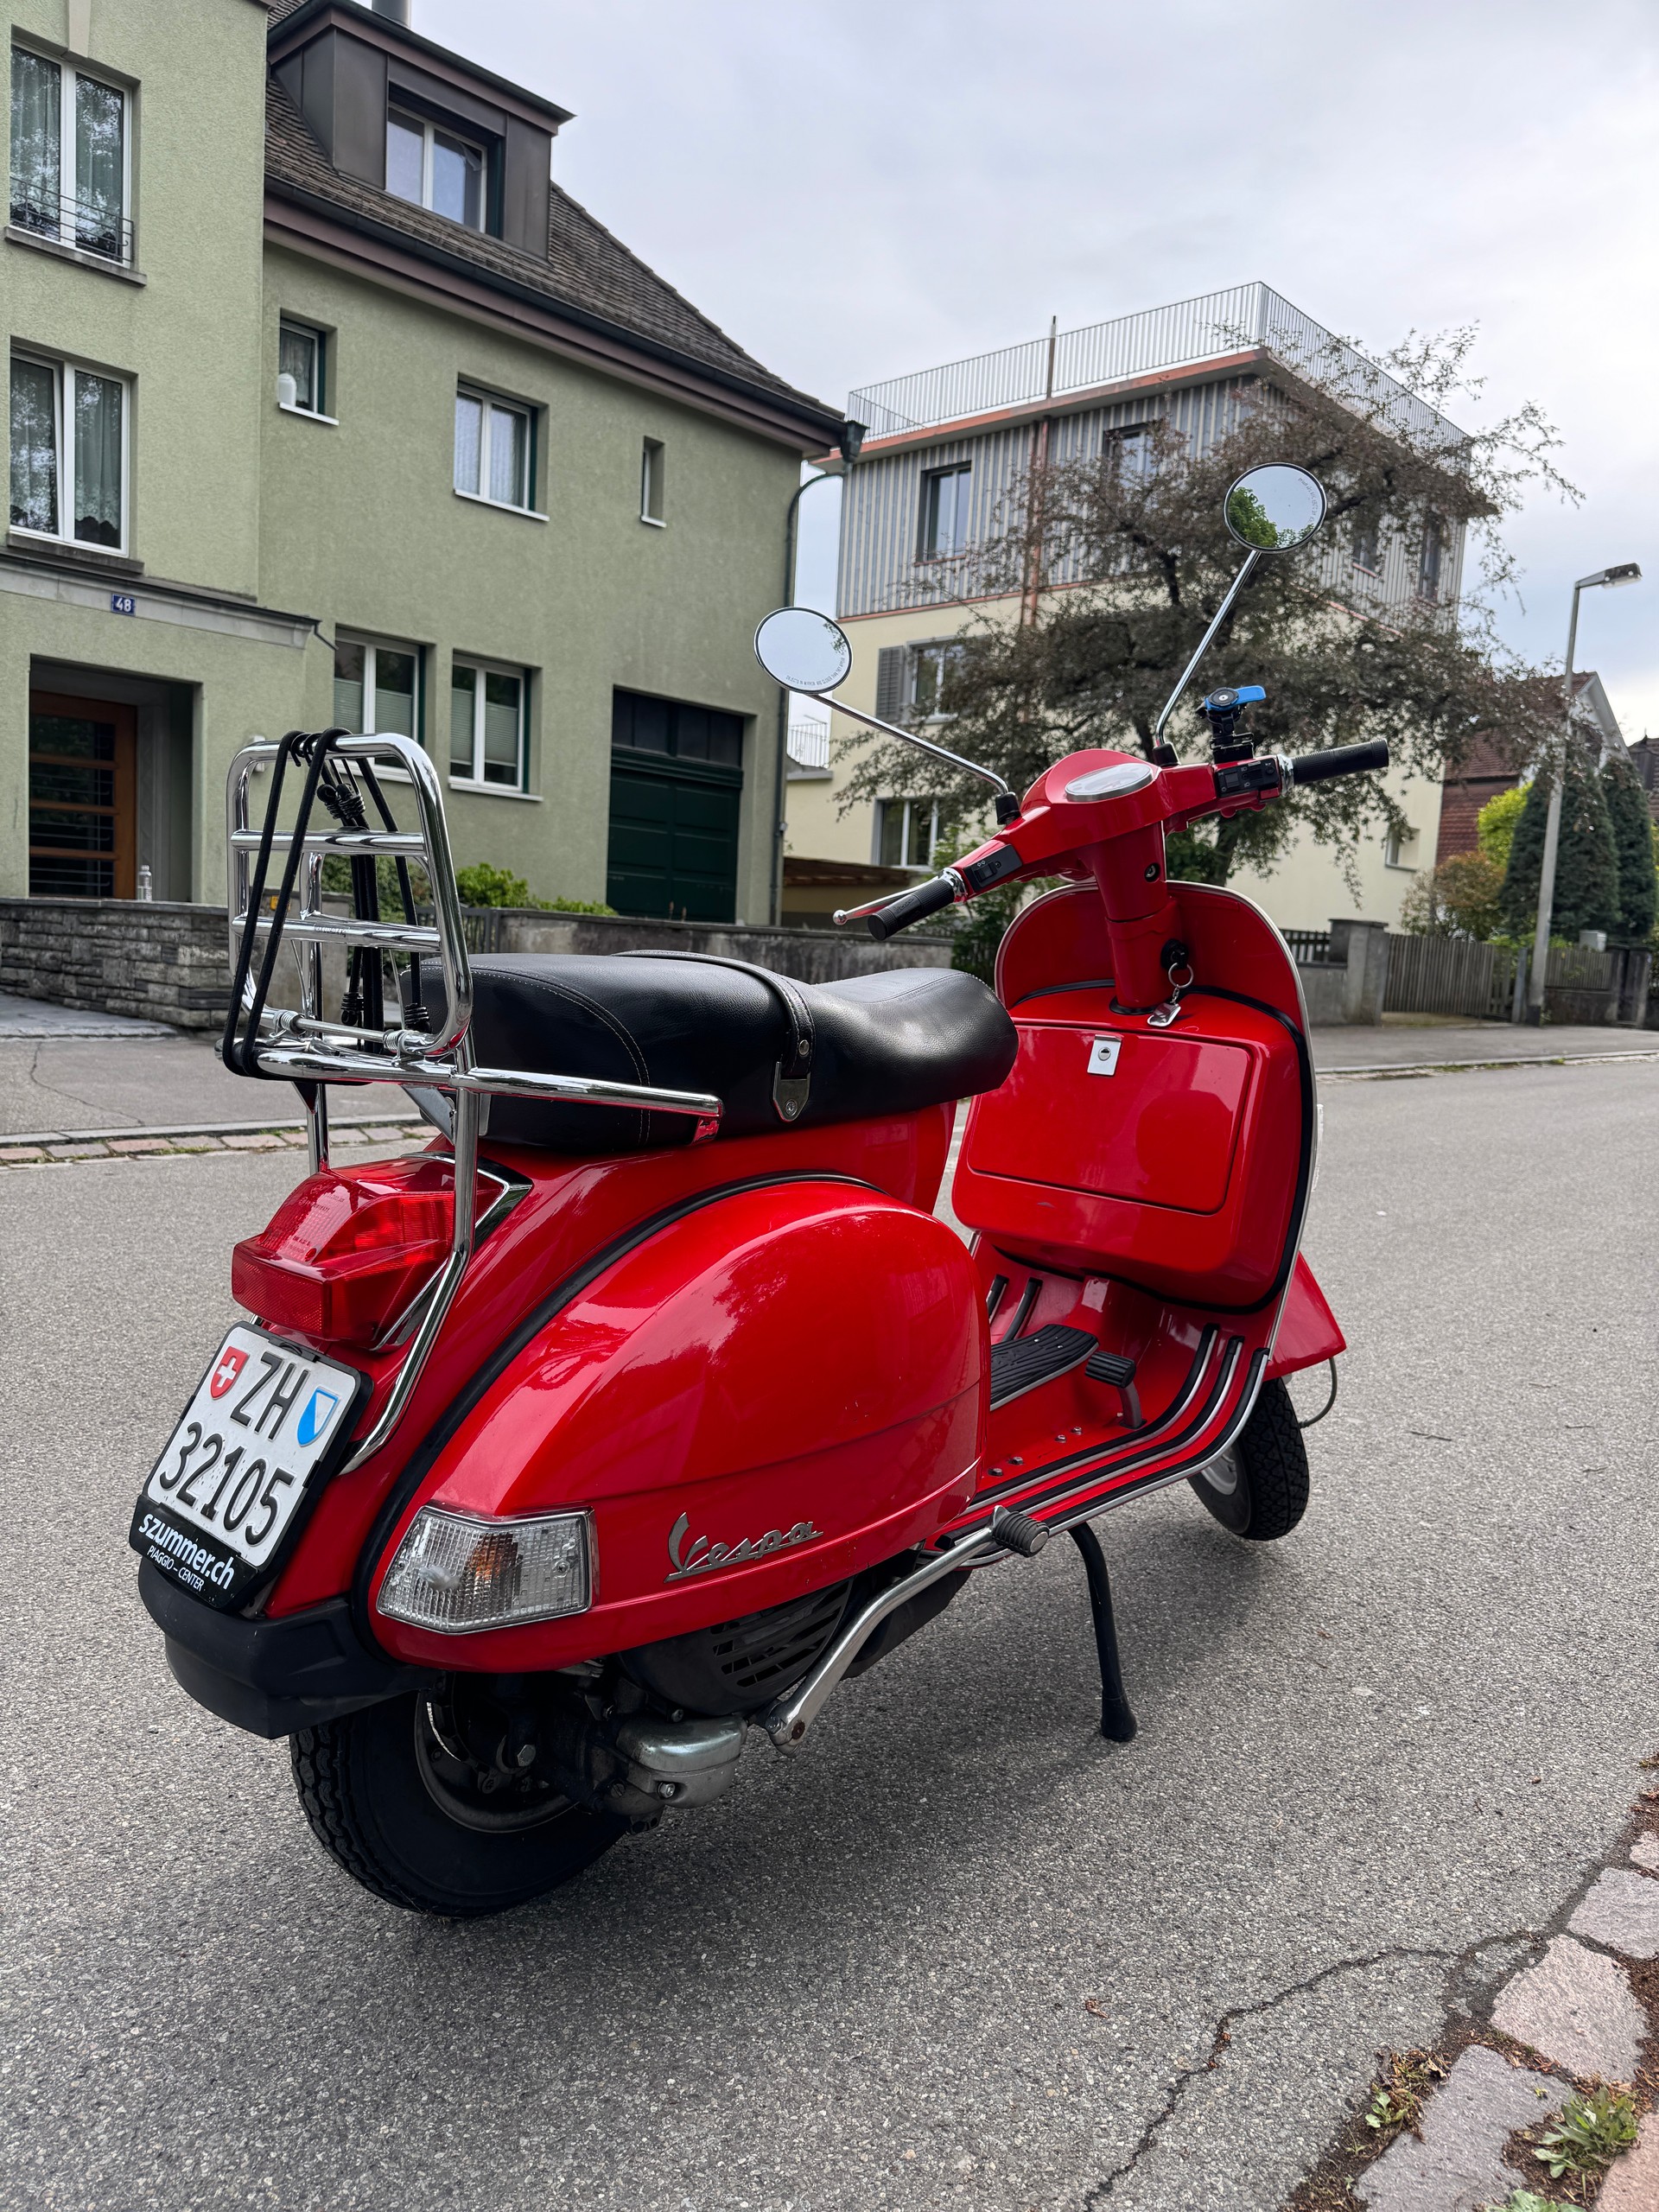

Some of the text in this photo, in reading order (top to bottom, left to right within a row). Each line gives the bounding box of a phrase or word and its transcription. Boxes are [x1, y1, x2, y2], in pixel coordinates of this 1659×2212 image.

[116, 597, 131, 612] 48
[231, 1351, 311, 1440] ZH
[159, 1421, 296, 1546] 32105
[138, 1513, 234, 1590] szummer.ch
[147, 1545, 175, 1570] PIAGGIO
[178, 1567, 205, 1592] CENTER
[664, 1511, 823, 1583] Vespa
